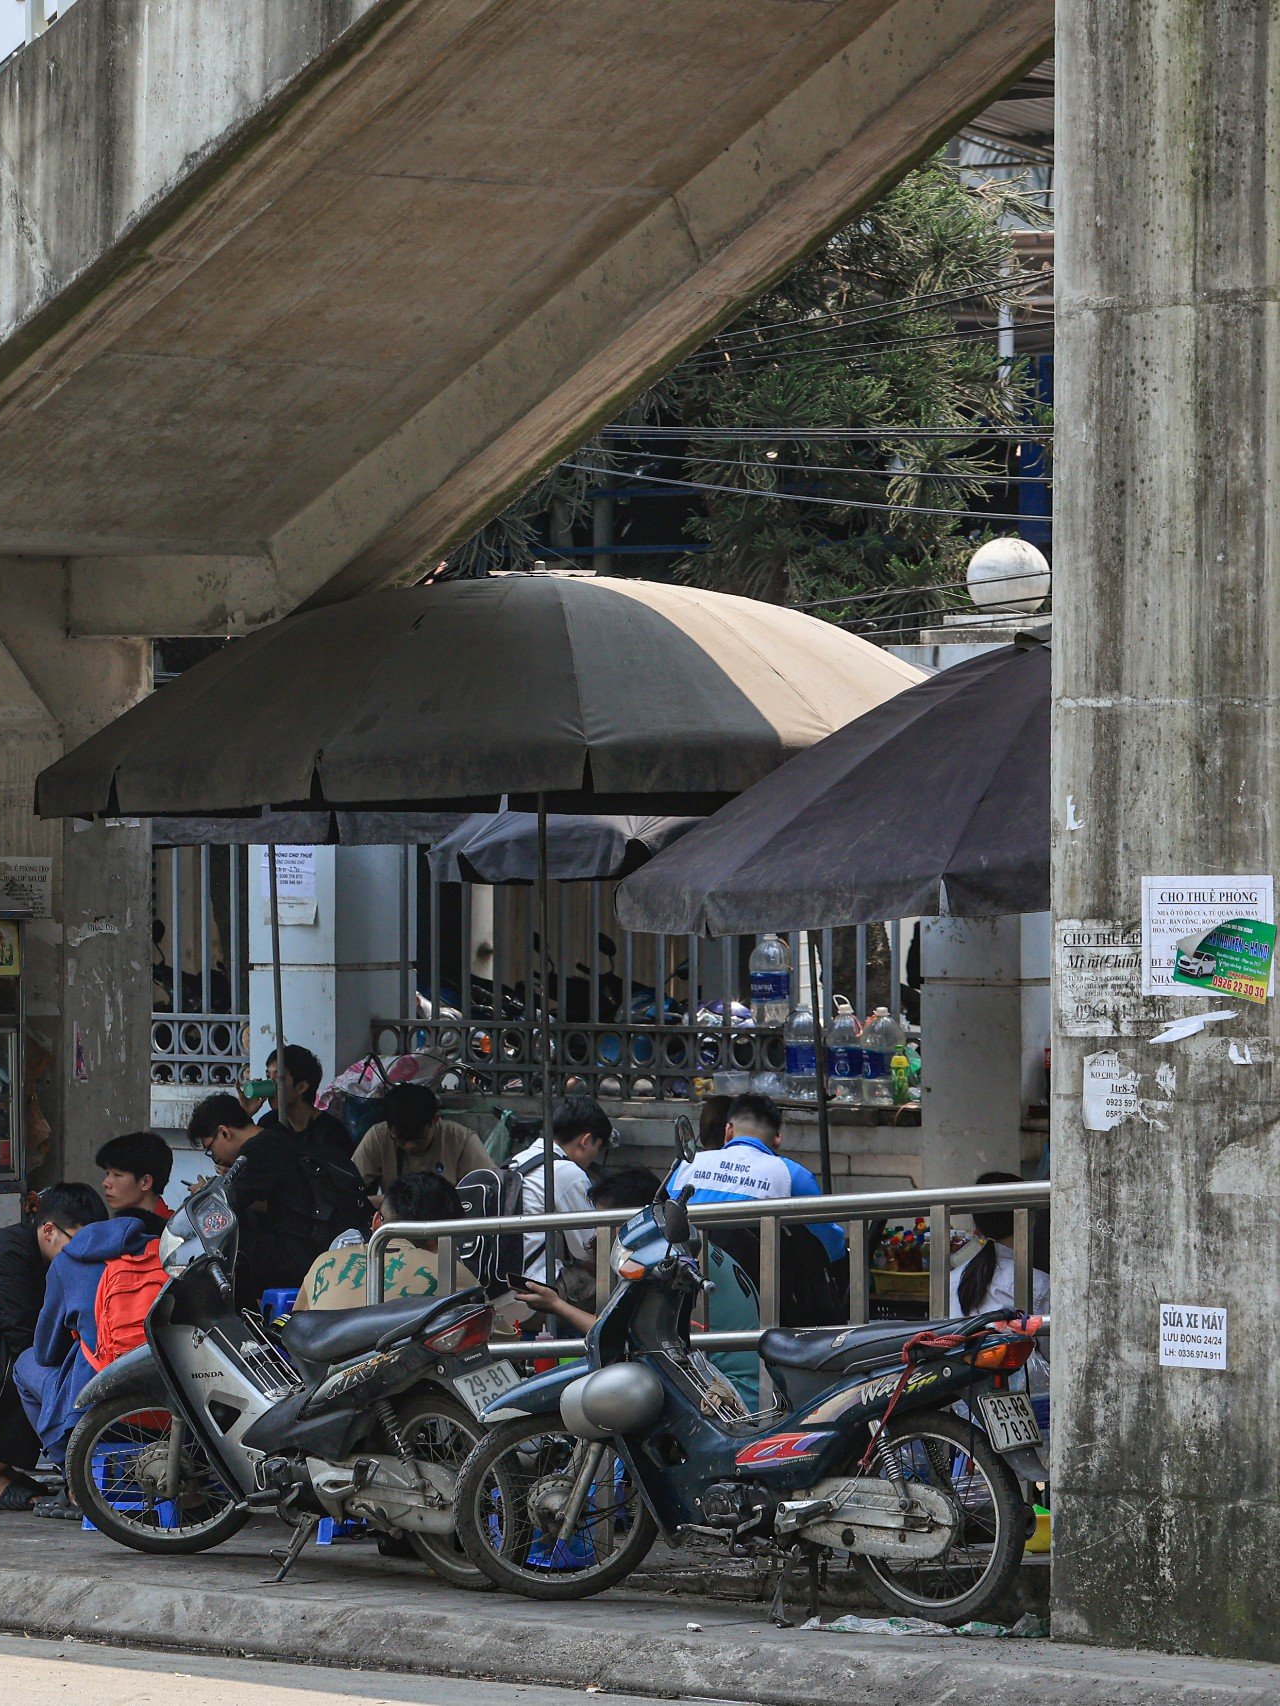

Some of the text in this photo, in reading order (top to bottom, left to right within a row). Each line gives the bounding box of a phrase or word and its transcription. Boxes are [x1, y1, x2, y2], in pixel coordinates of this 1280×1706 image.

[1160, 889, 1258, 902] CHO THUÊ PHÒNG
[1064, 933, 1090, 945] CHO
[1068, 954, 1084, 968] Mi
[1233, 981, 1242, 992] 22
[1244, 983, 1254, 995] 30
[1255, 987, 1265, 998] 30
[1106, 1098, 1122, 1106] 0923
[720, 1161, 751, 1173] ĐẠI HỌC
[694, 1170, 771, 1191] GIAO THÔNG VẬN TẢI
[1163, 1307, 1224, 1330] SỬA XE MÁY
[1163, 1333, 1222, 1345] LƯU ĐỘNG 24/24
[464, 1353, 482, 1361] HONDA
[465, 1366, 511, 1396] 29-B1
[1000, 1420, 1039, 1444] 7830
